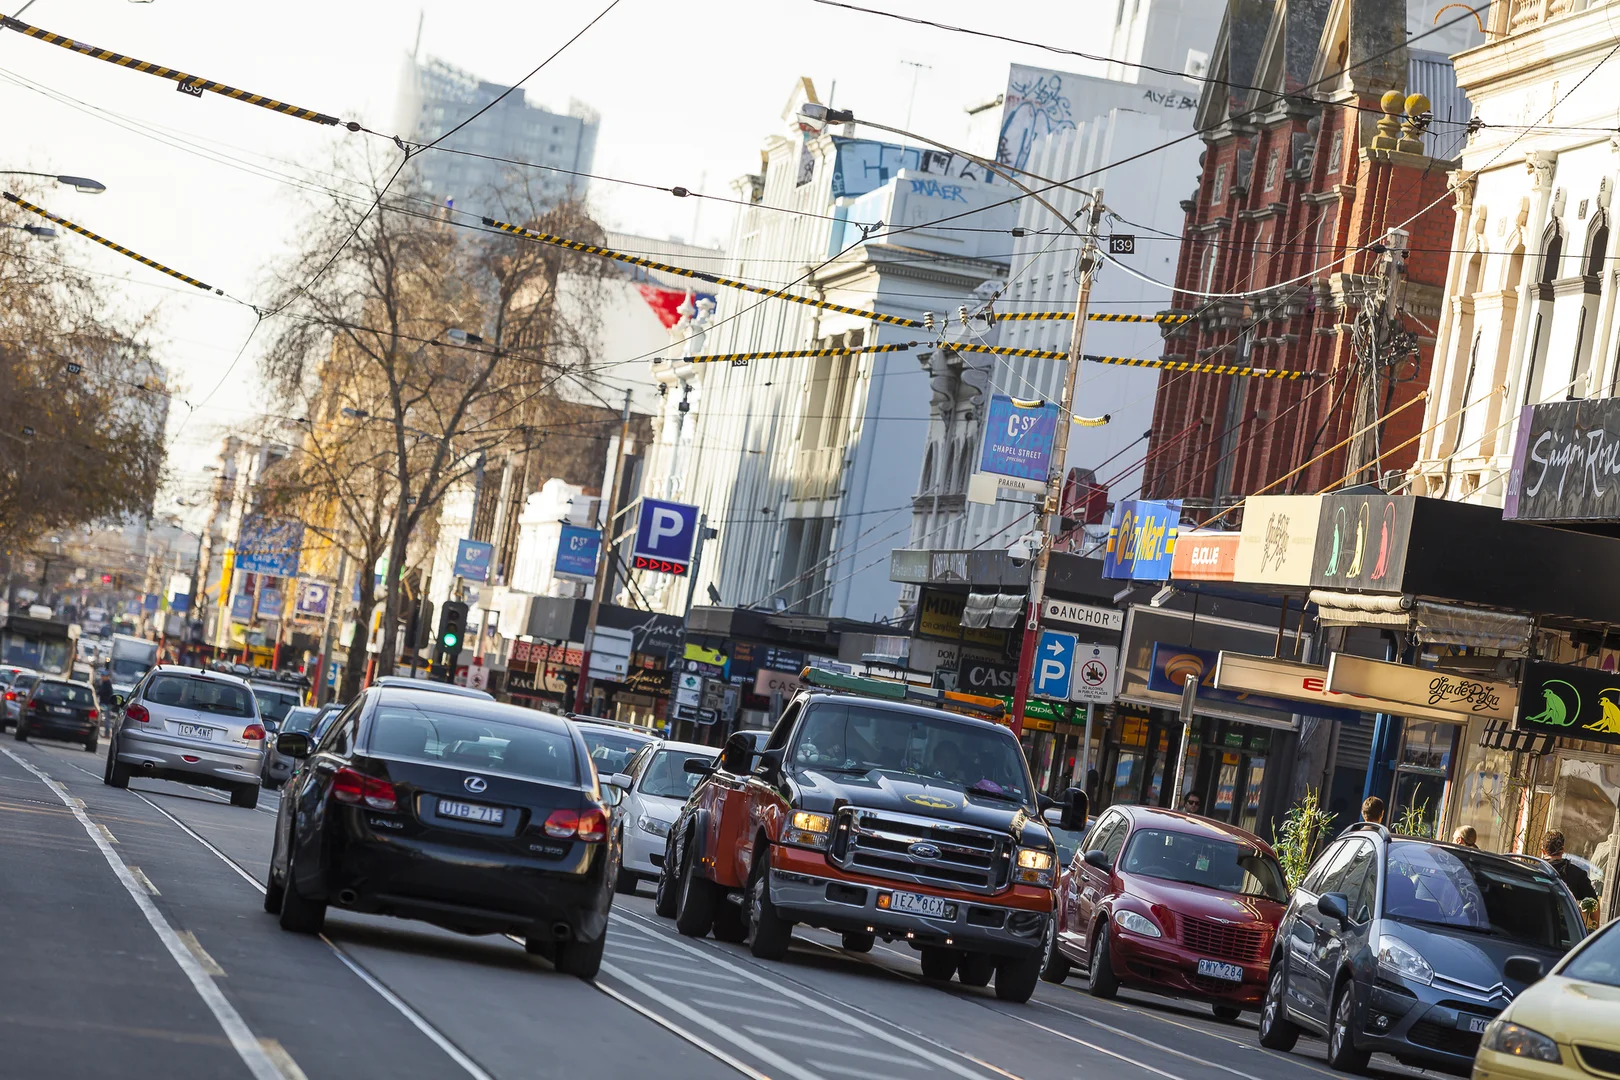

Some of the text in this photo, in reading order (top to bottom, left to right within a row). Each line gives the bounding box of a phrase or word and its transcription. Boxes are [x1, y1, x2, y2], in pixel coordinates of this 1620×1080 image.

[1111, 239, 1133, 252] 139
[992, 444, 1042, 460] CHAPEL STREET
[997, 478, 1026, 489] PRAHRAN
[647, 506, 684, 550] P
[303, 586, 325, 610] P
[1060, 605, 1120, 626] ANCHOR PL
[1038, 658, 1066, 690] P
[921, 898, 943, 913] 8CX
[1200, 960, 1242, 979] RWY 284
